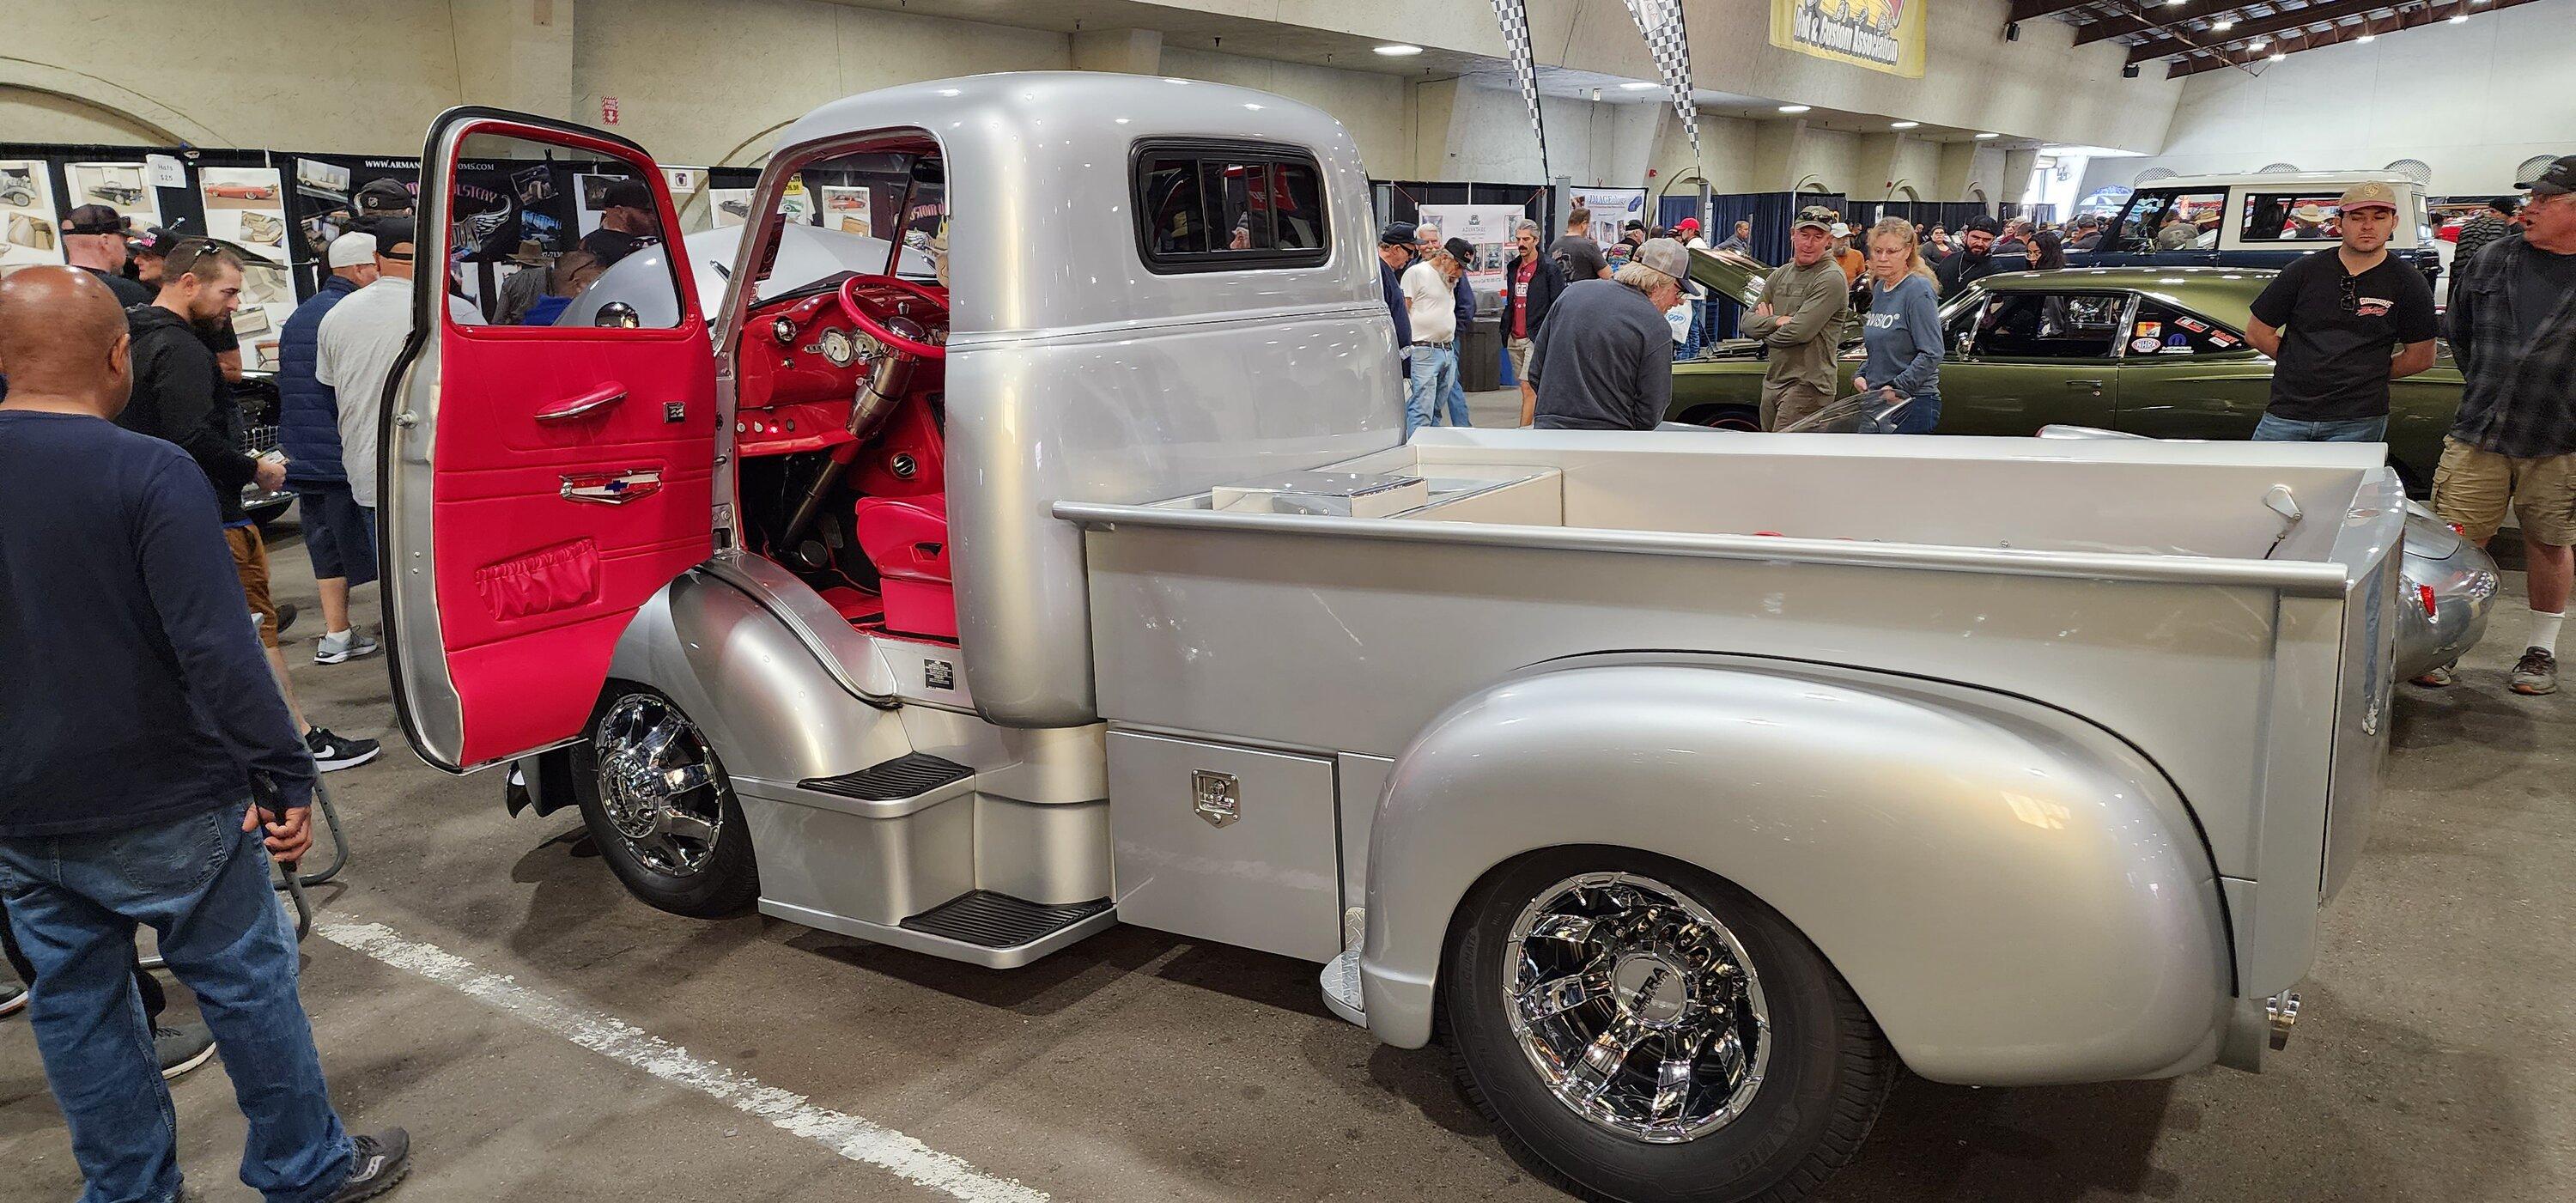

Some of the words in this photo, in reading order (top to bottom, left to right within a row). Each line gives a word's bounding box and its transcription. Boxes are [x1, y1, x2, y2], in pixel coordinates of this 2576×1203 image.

[1810, 17, 1820, 43] &
[1819, 15, 1854, 52] Custom
[1852, 24, 1899, 64] Association
[365, 160, 421, 170] WWW.ARMAN
[458, 161, 495, 171] OMS.COM
[1628, 967, 1671, 1012] ULTRA
